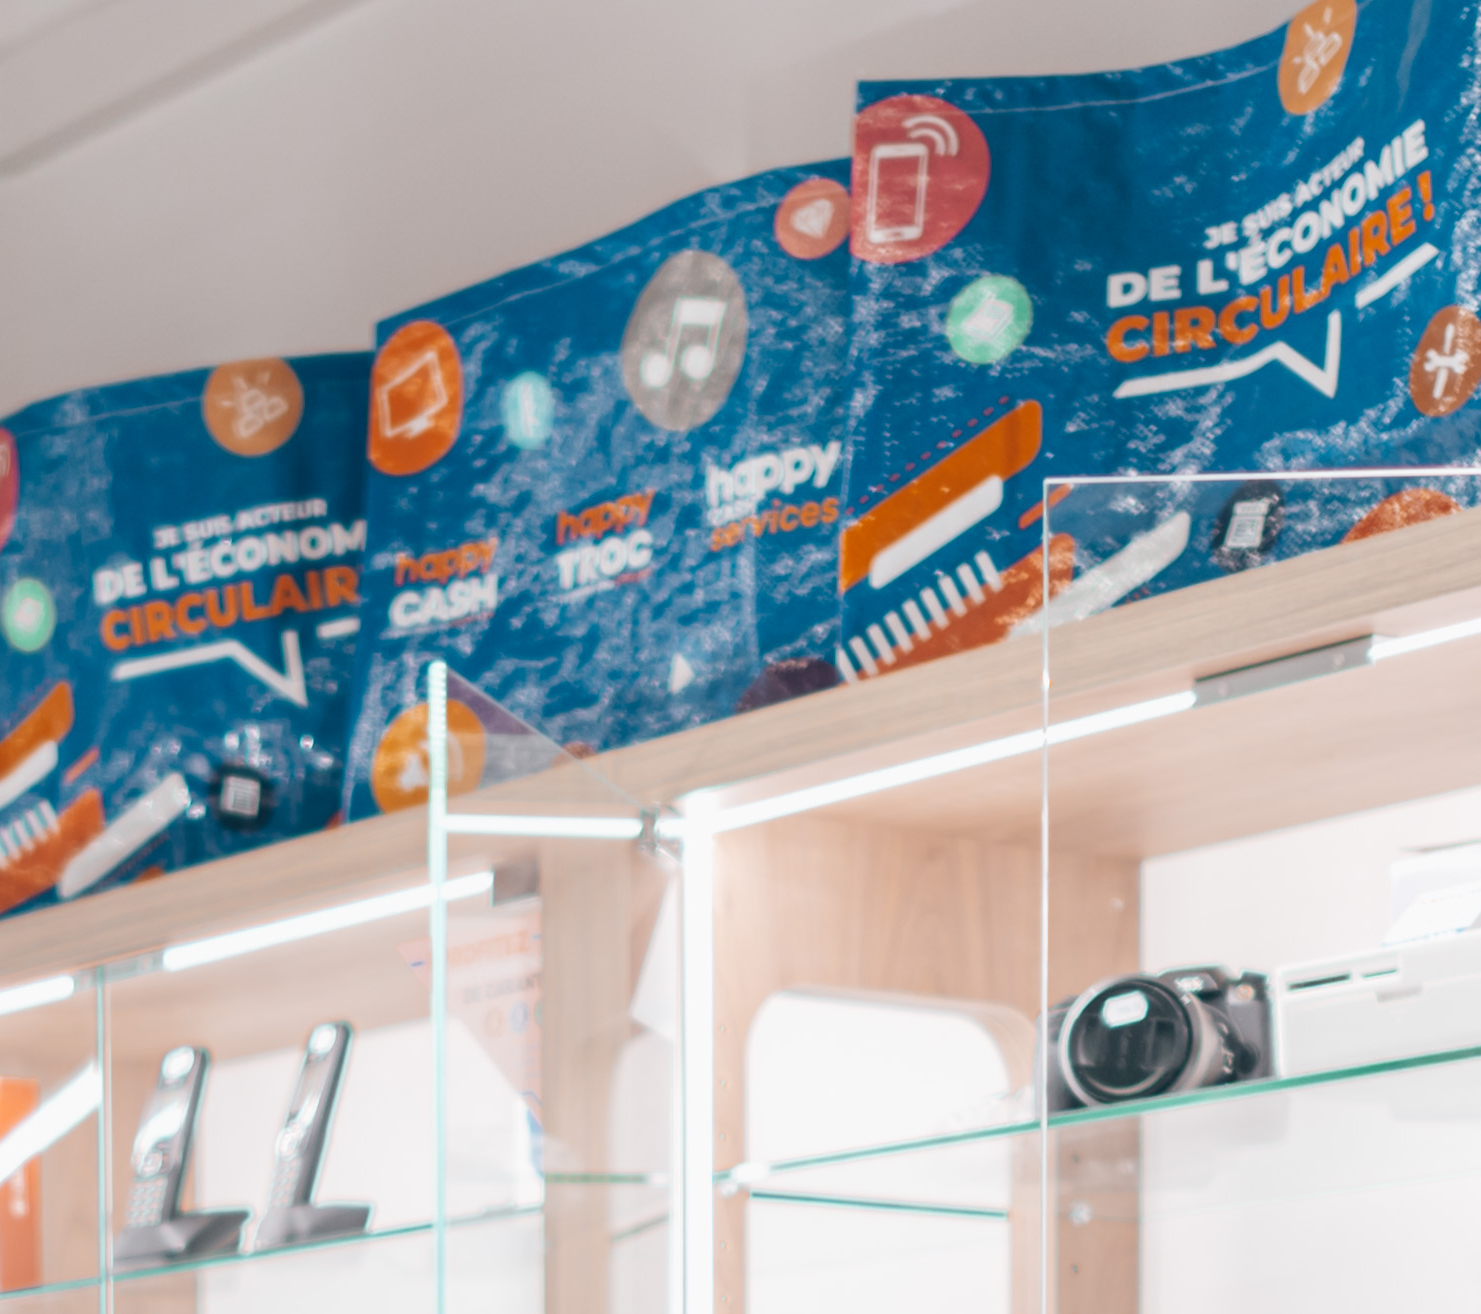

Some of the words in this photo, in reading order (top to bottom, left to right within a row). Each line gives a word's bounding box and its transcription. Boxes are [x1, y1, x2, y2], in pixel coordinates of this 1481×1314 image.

[1106, 266, 1181, 308] DE
[1197, 119, 1429, 295] L'ÉCONOMIE
[1204, 222, 1237, 249] JE
[1242, 193, 1292, 236] SUIS
[1294, 137, 1365, 207] ACTEUR
[1106, 186, 1416, 362] CIRCULAIRE
[706, 441, 842, 507] happy
[153, 527, 182, 550] JE
[183, 514, 232, 543] SUIS
[236, 498, 327, 531] ACTEUR
[556, 489, 656, 545] happy
[709, 498, 840, 552] services
[93, 562, 147, 607] DE
[395, 537, 499, 585] happy
[556, 530, 653, 590] TROC
[389, 574, 499, 629] CASH
